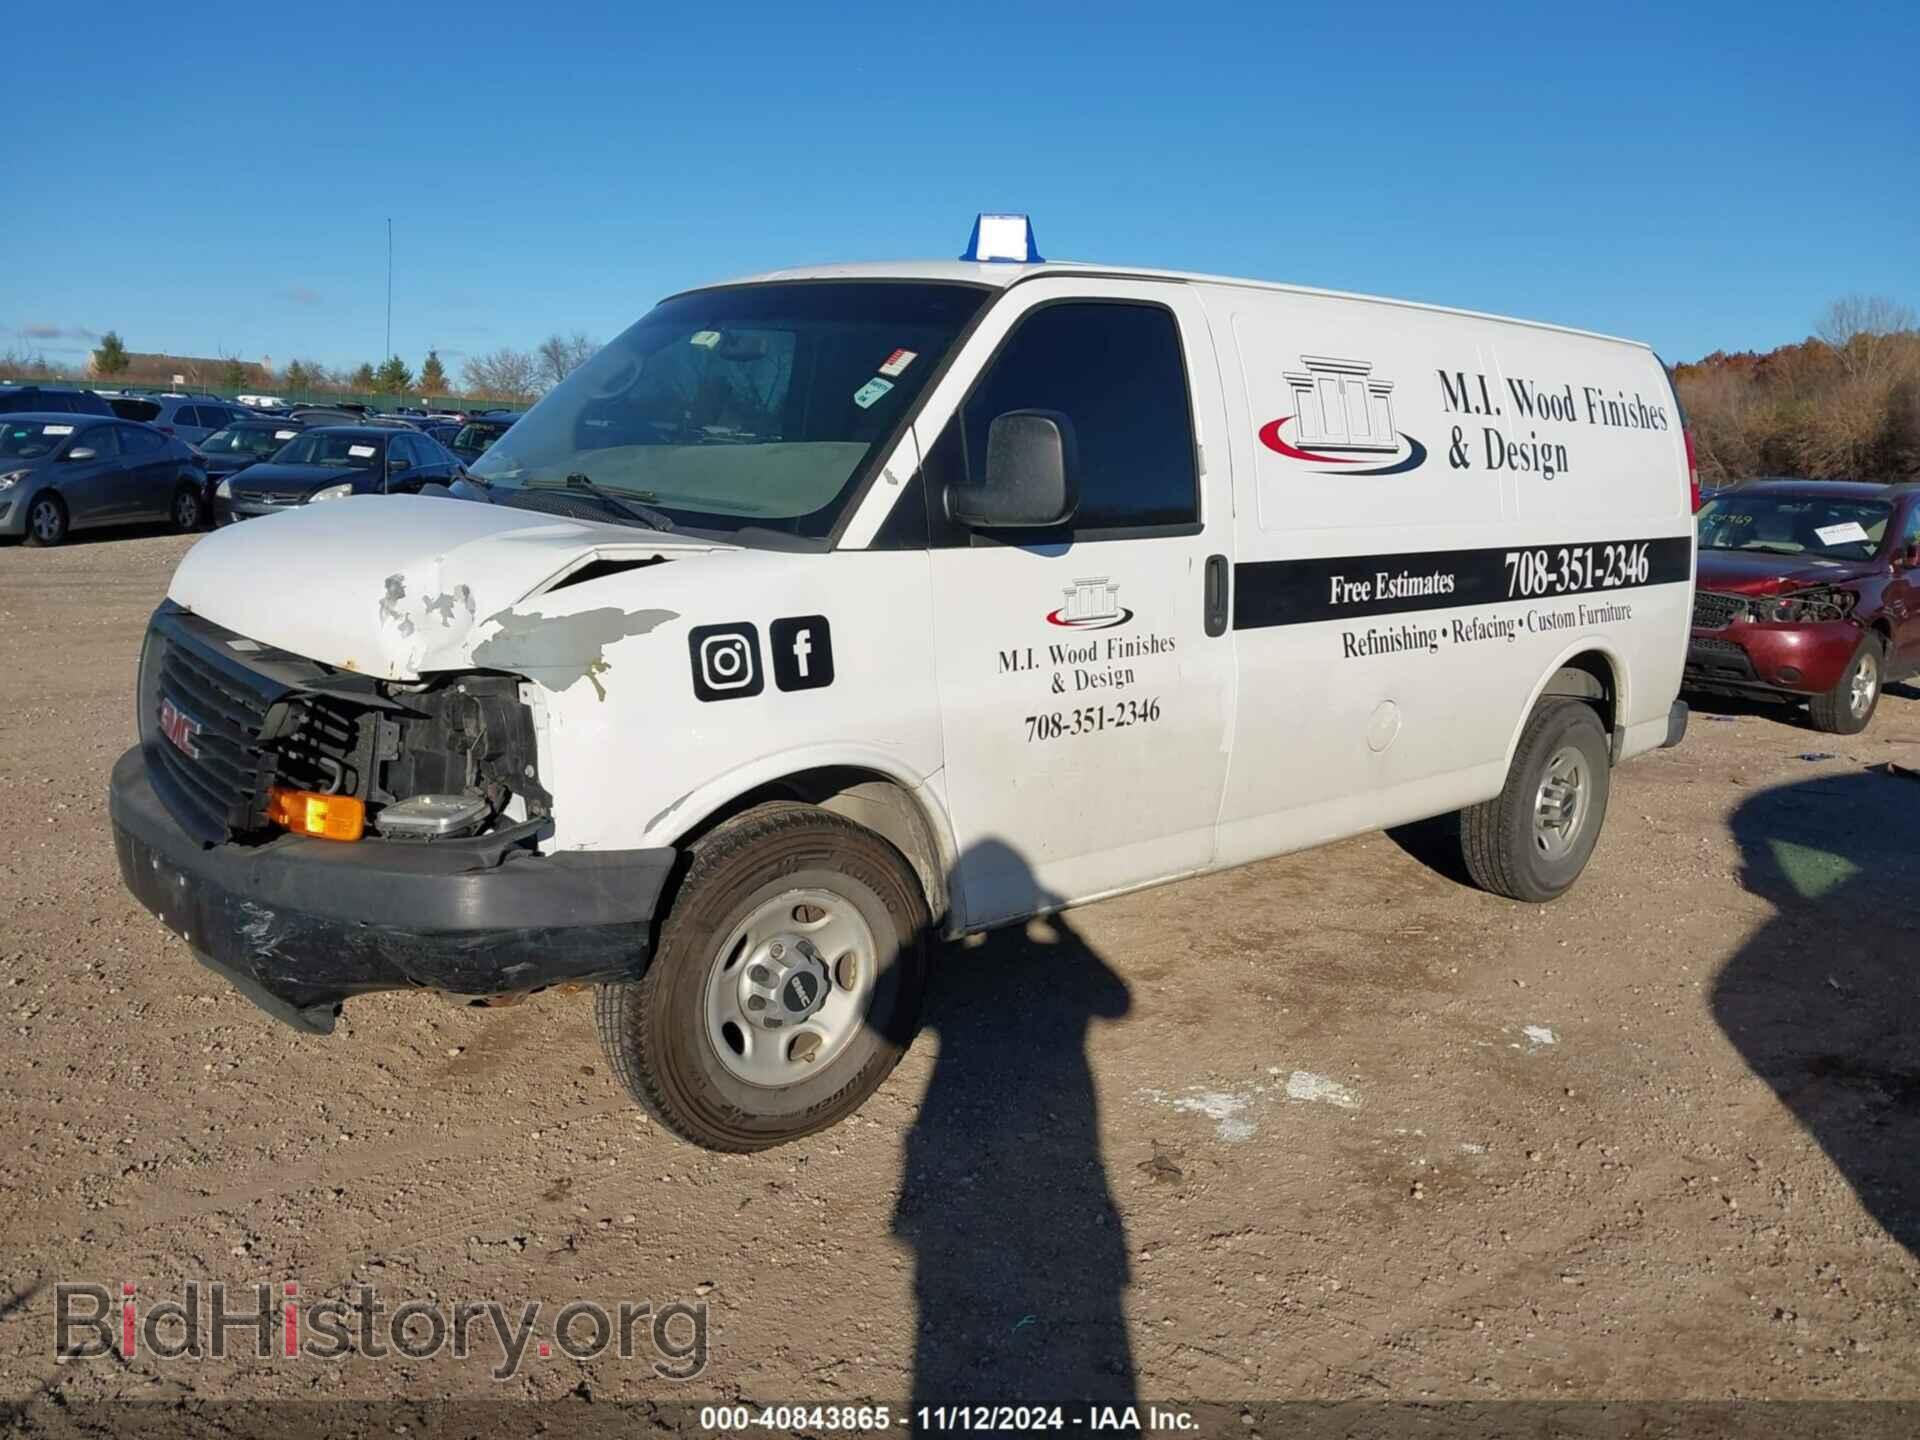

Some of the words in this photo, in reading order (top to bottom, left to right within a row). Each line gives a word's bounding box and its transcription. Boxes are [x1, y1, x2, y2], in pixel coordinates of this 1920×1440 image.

[1436, 369, 1501, 416] M.I.
[1506, 378, 1577, 423] Wood
[1582, 386, 1668, 432] Finishes
[1449, 425, 1470, 470] &
[1482, 426, 1569, 480] Design
[1328, 575, 1371, 605] Free
[1375, 570, 1455, 600] Estimates
[1504, 543, 1650, 598] 708-351-2346
[998, 648, 1040, 674] M.I.
[1049, 640, 1097, 666] Wood
[1107, 633, 1176, 661] Finishes
[1342, 624, 1438, 659] Refinishing
[1451, 614, 1515, 644] Refacing
[1527, 607, 1576, 633] Custom
[1579, 601, 1632, 627] Furniture
[1051, 671, 1066, 694] &
[1074, 665, 1135, 691] Design
[1025, 696, 1161, 744] 708-351-2346
